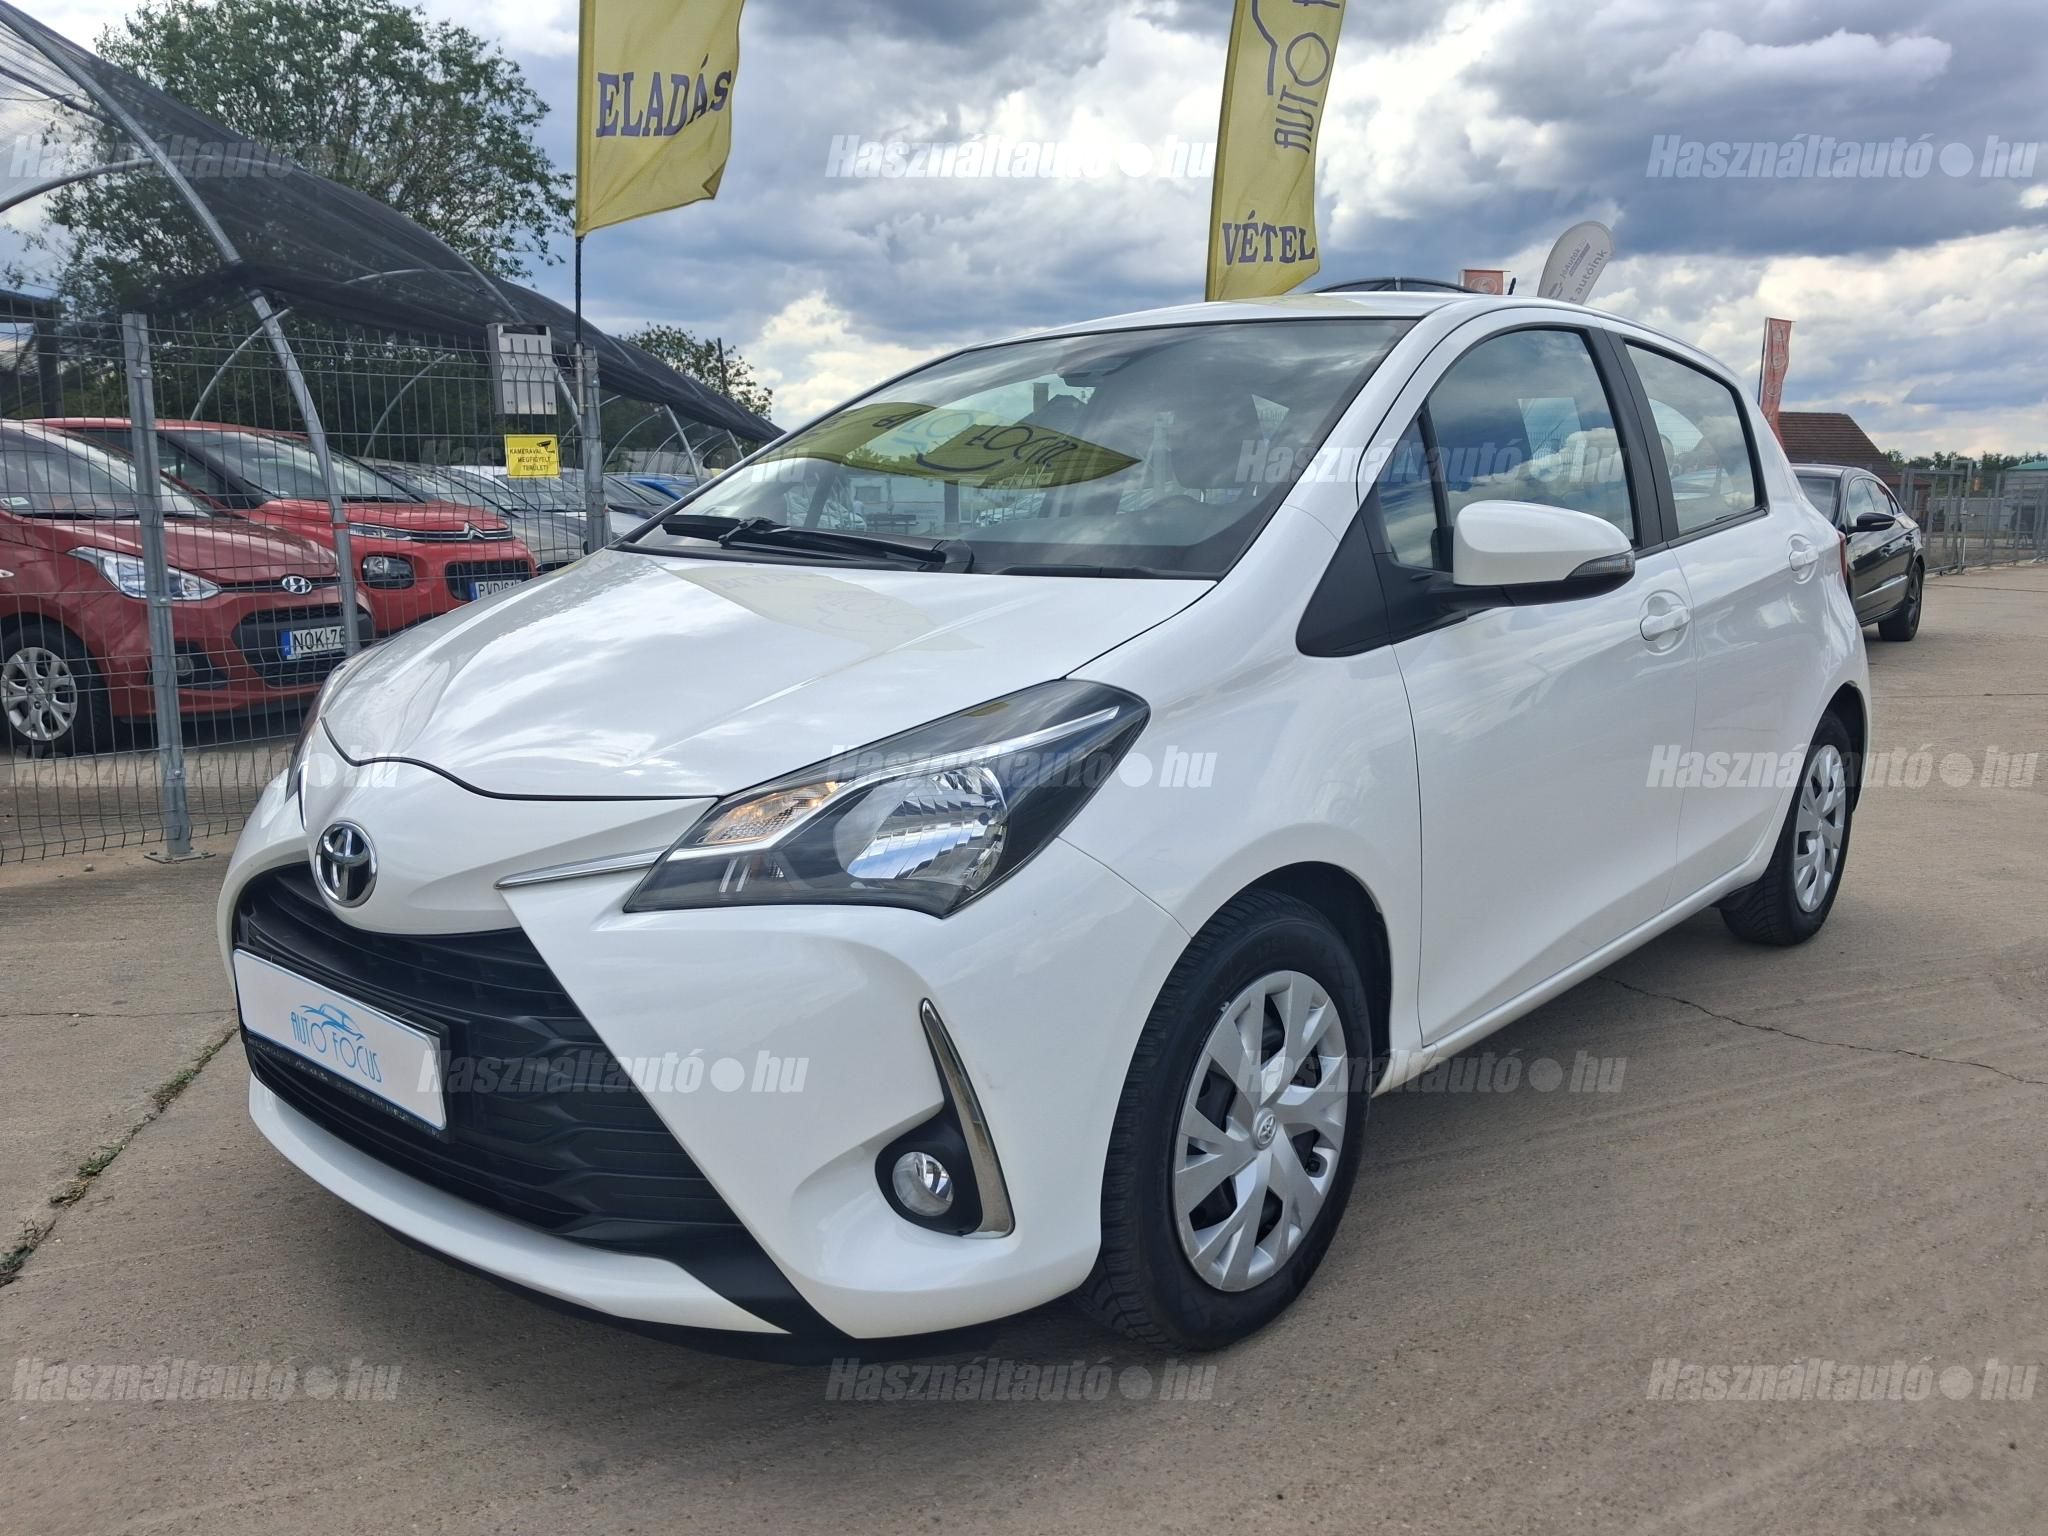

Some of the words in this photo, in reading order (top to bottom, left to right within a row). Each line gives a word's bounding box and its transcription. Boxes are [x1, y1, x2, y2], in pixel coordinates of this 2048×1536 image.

[595, 53, 732, 138] ELADÁS
[1221, 209, 1316, 266] VÉTEL
[290, 1011, 327, 1054] AUTO
[331, 1031, 382, 1083] FOCUS
